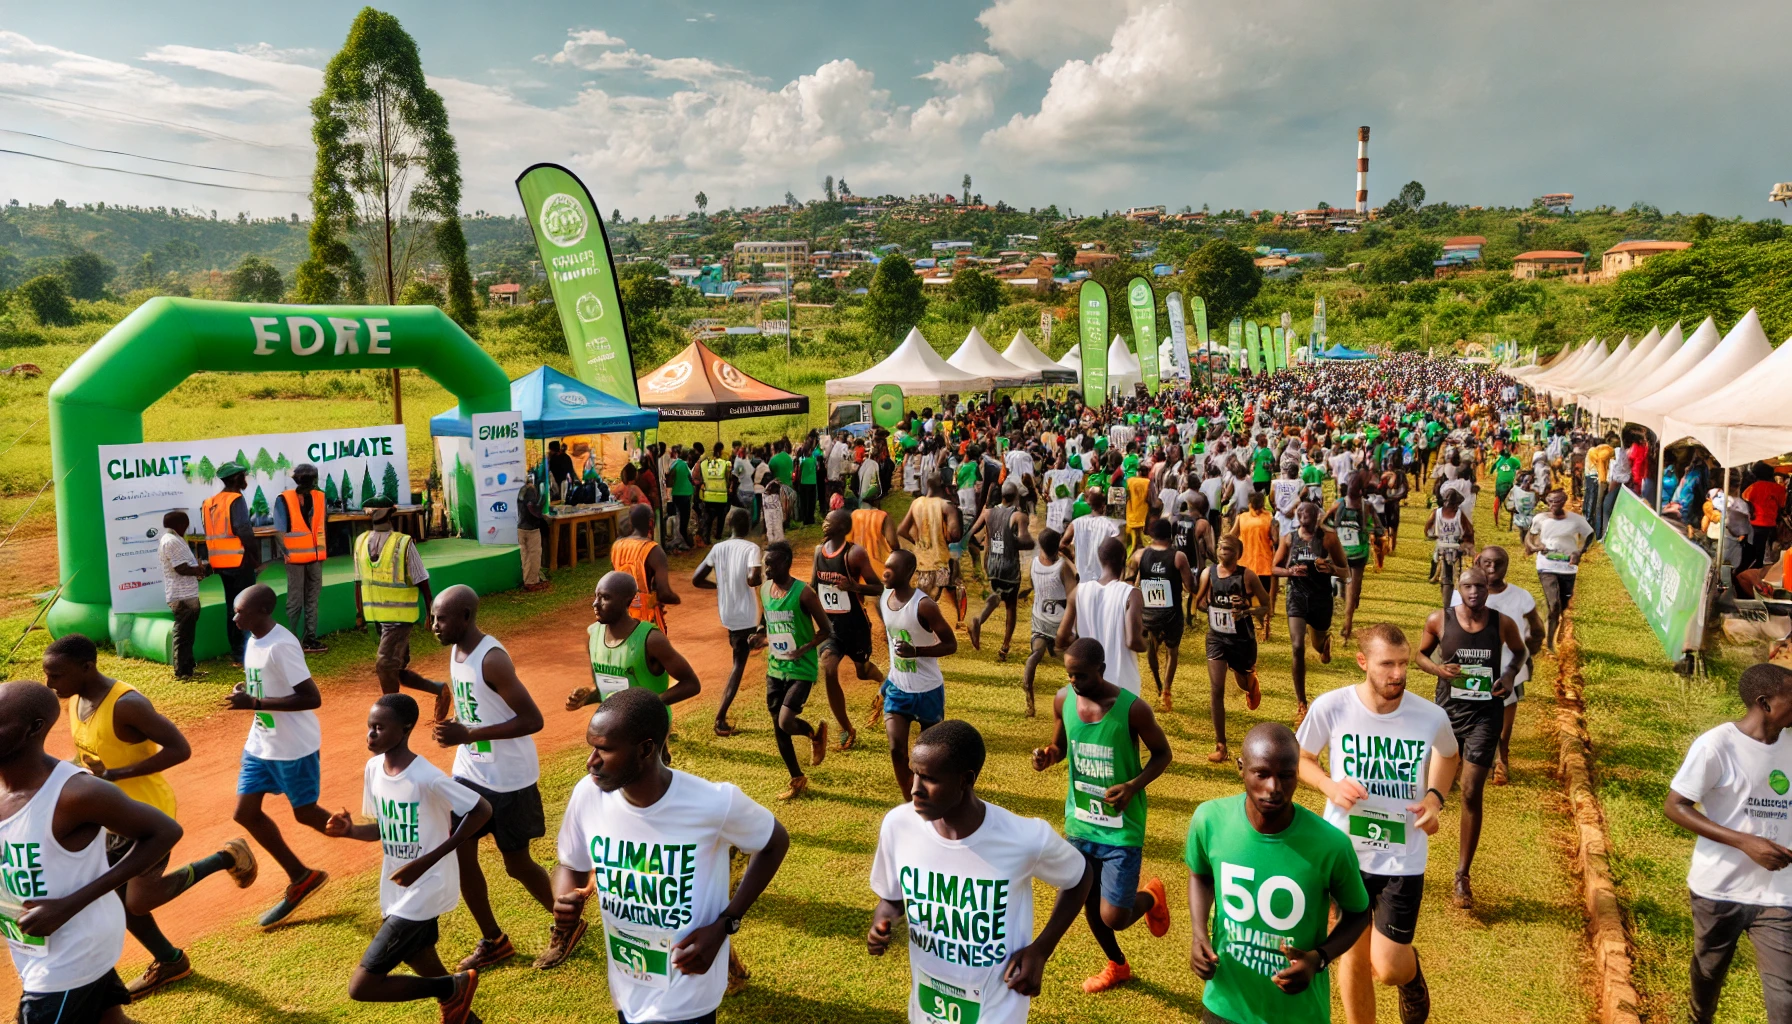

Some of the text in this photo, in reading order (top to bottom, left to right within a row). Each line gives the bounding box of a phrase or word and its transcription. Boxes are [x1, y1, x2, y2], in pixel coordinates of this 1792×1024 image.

[107, 454, 191, 480] CLIMATE
[307, 436, 394, 463] CLIMATE
[1341, 733, 1426, 761] CLIMATE
[590, 835, 697, 876] CLIMATE
[595, 866, 695, 908] CHANGE
[900, 865, 1010, 912] CLIMATE
[1221, 861, 1307, 931] 50
[906, 898, 1006, 944] CHANGE
